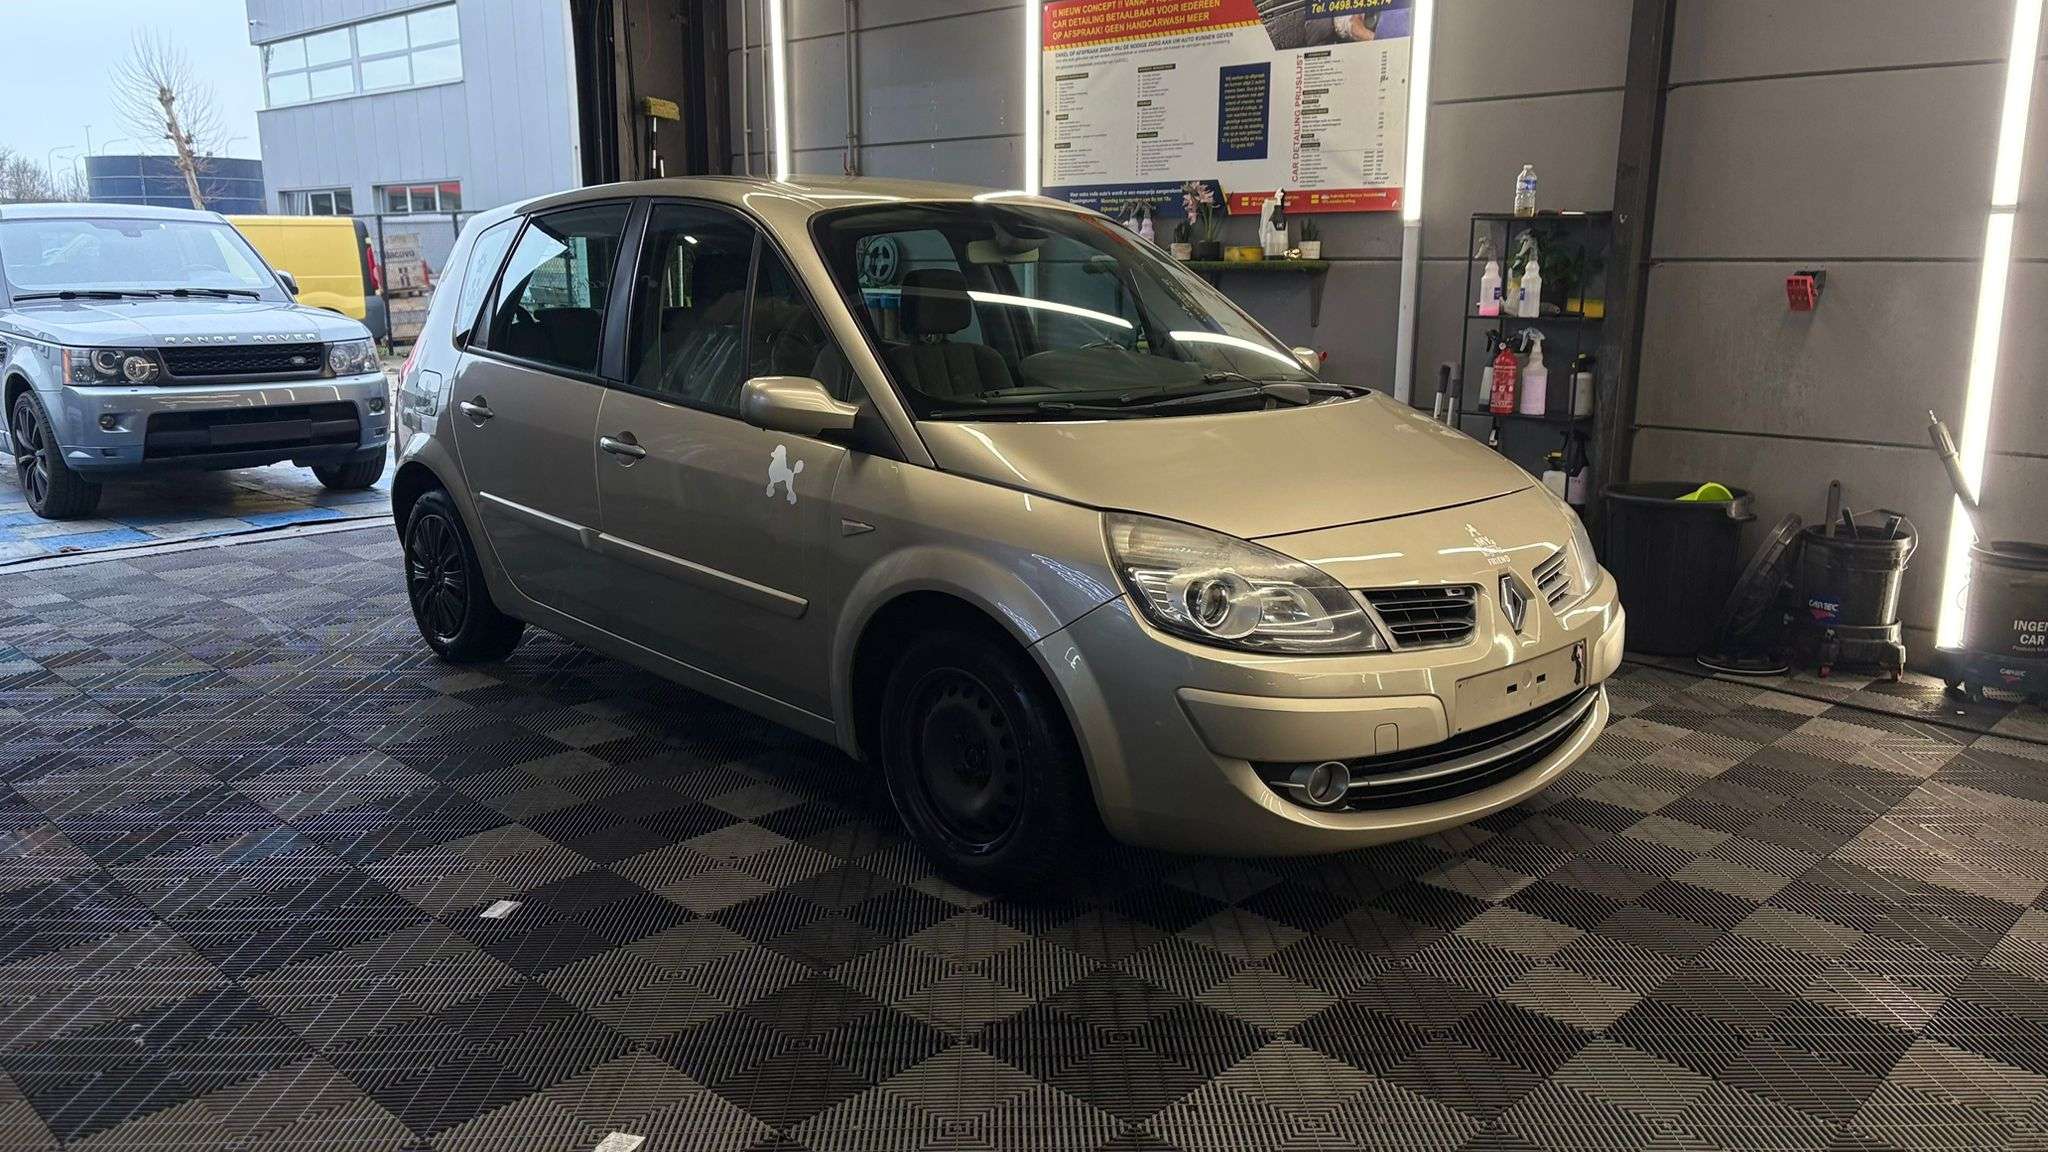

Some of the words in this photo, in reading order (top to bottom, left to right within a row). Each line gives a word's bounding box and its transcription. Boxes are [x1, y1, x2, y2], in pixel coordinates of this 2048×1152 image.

[1052, 20, 1067, 29] CAR
[1068, 14, 1105, 27] DETAILING
[1105, 7, 1155, 21] BETAALBAAR
[1156, 3, 1180, 15] VOOR
[1180, 0, 1221, 12] IEDEREEN
[1058, 6, 1081, 17] NIEUW
[1082, 1, 1116, 13] CONCEPT
[1052, 31, 1063, 40] OP
[1104, 23, 1125, 34] GEEN
[1126, 15, 1186, 31] HANDCARWASH
[1187, 11, 1210, 23] MEER
[1293, 109, 1301, 160] DETAILING
[164, 335, 237, 345] RANGE
[252, 333, 316, 343] ROVER
[2020, 634, 2045, 646] CAR
